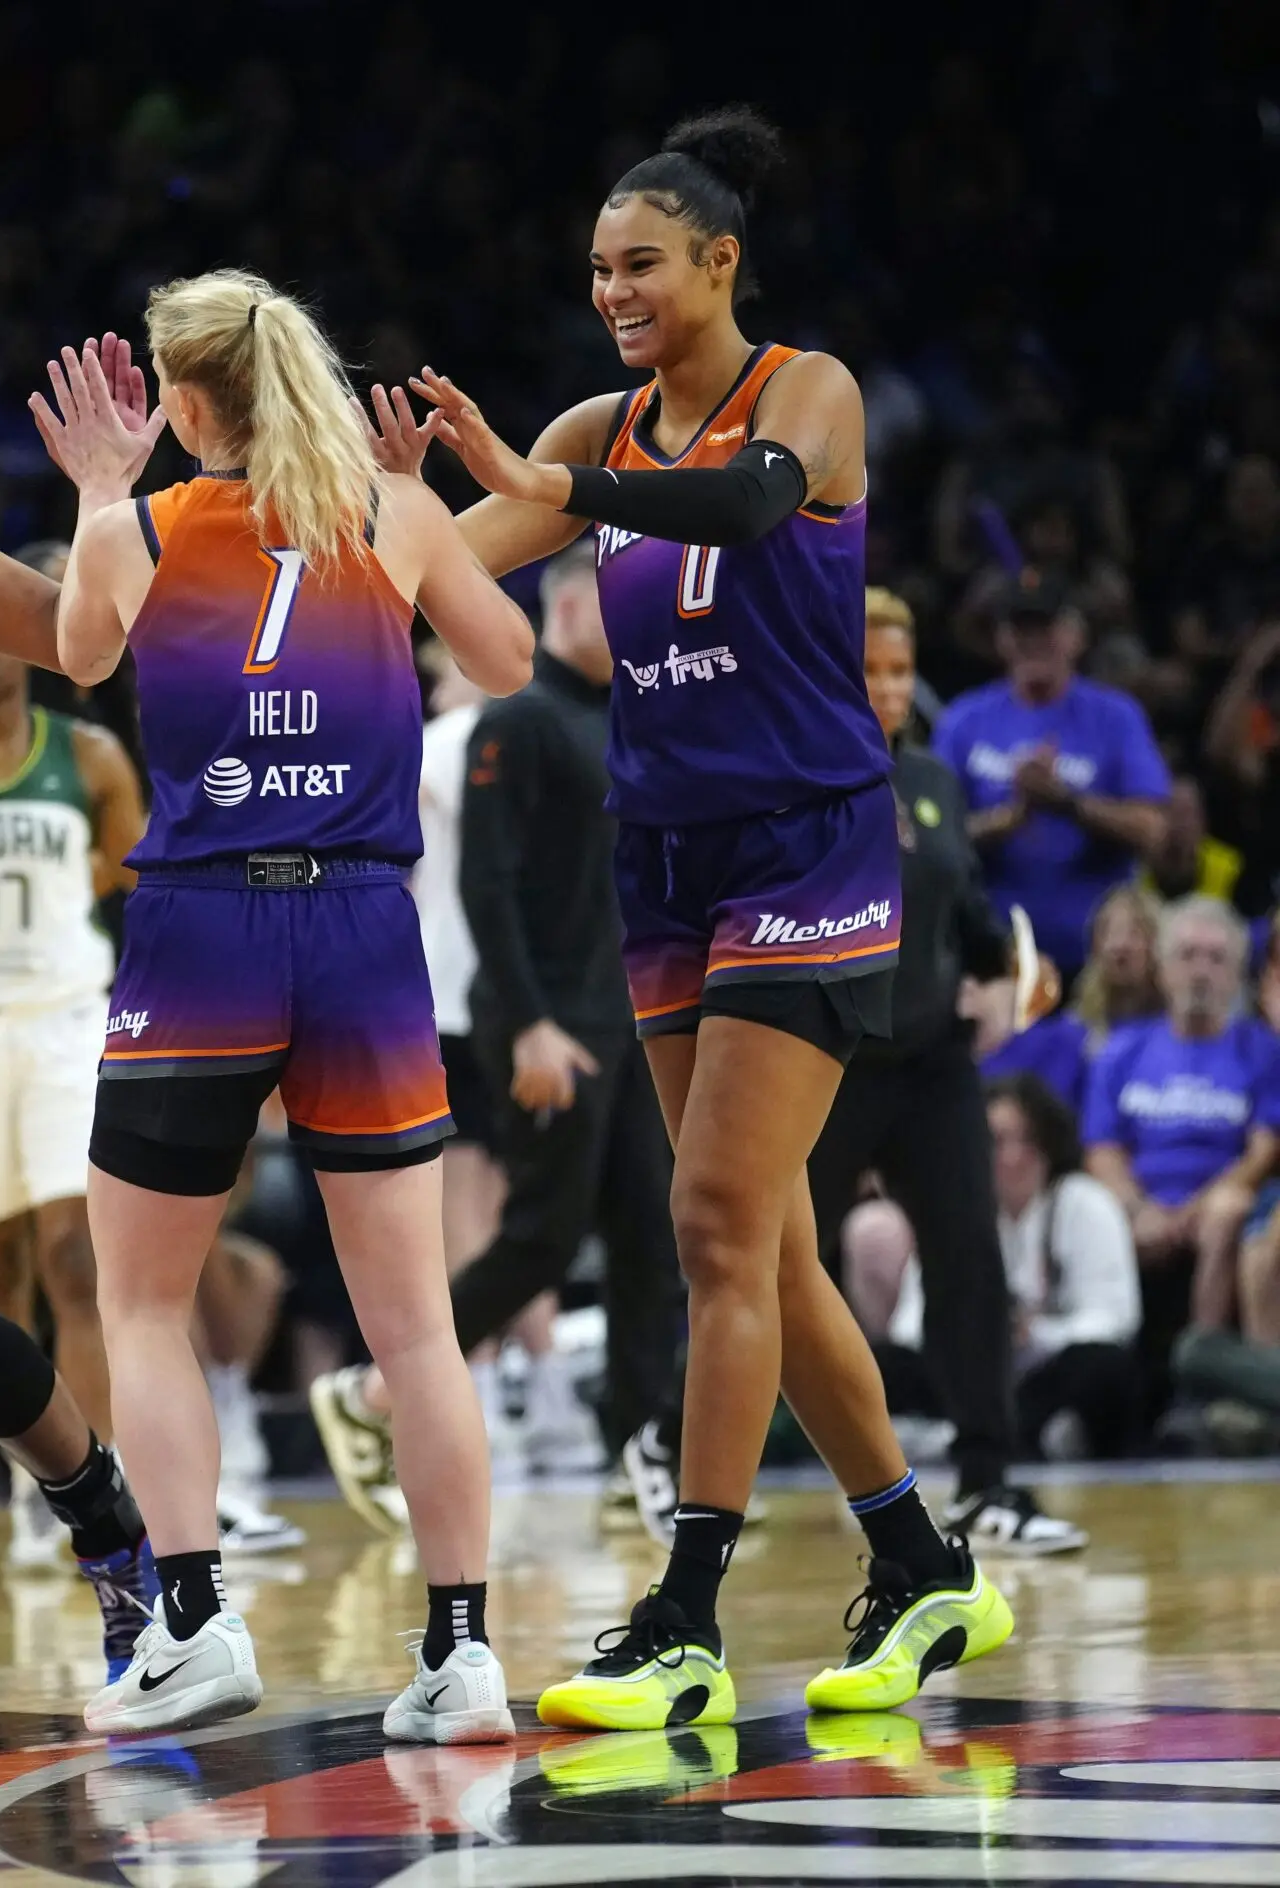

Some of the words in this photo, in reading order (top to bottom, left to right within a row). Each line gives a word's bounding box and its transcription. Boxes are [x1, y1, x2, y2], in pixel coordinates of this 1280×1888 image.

[242, 548, 306, 674] 1
[249, 690, 318, 736] HELD
[259, 764, 351, 797] AT&T
[750, 899, 892, 945] Mercury
